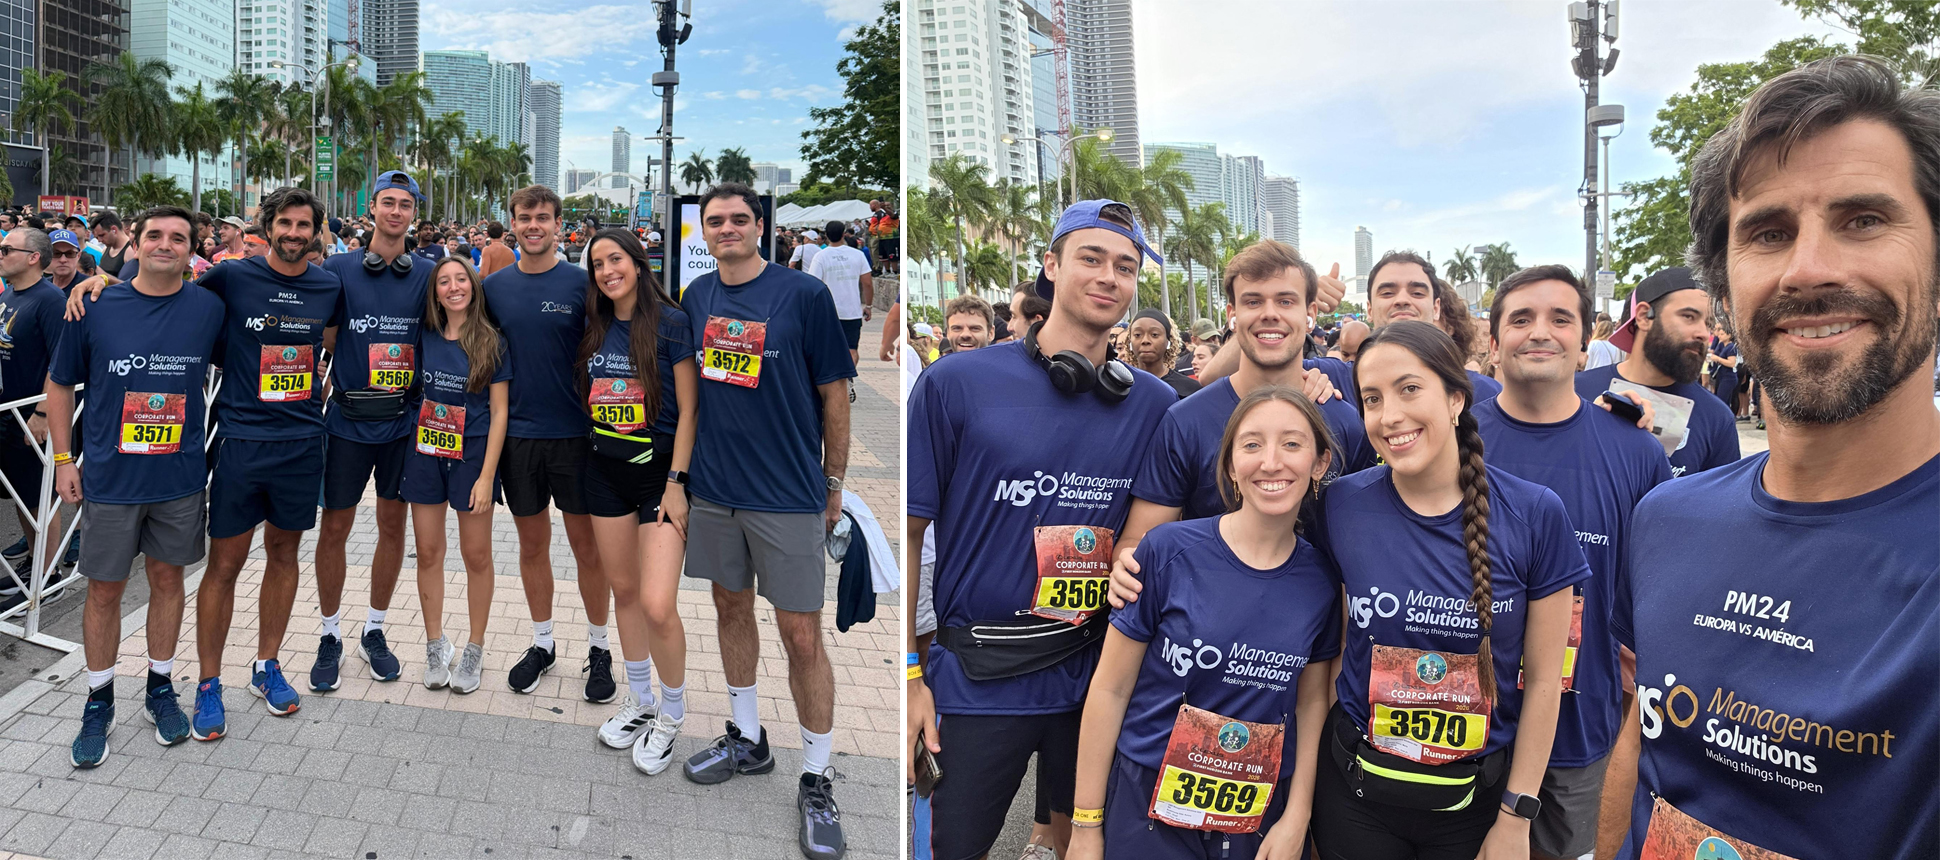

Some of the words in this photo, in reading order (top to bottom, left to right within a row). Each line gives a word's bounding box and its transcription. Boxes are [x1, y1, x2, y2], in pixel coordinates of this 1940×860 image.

[280, 314, 323, 325] Management
[280, 322, 310, 330] Solutions
[379, 322, 408, 330] Solutions
[148, 362, 186, 371] Solutions
[149, 354, 202, 364] Management
[712, 350, 752, 374] 3572
[270, 374, 304, 390] 3574
[376, 370, 410, 386] 3568
[434, 378, 463, 389] Solutions
[598, 405, 636, 422] 3570
[133, 425, 172, 442] 3571
[422, 428, 456, 449] 3569
[1058, 487, 1113, 500] Solutions
[1057, 501, 1078, 509] Making
[1078, 502, 1095, 510] things
[1056, 560, 1098, 569] CORPORATE
[1050, 580, 1110, 608] 3568
[1724, 590, 1792, 622] PM24
[1405, 608, 1480, 629] Solutions
[1404, 625, 1430, 634] Making
[1430, 628, 1452, 638] things
[1693, 614, 1737, 632] EUROPA
[1738, 622, 1752, 635] VS
[1752, 628, 1814, 652] AMÉRICA
[1225, 660, 1292, 682] Solutions
[1222, 676, 1246, 686] Making
[1247, 680, 1266, 690] things
[1266, 683, 1287, 692] happen
[1391, 690, 1448, 702] CORPORATE
[1452, 694, 1470, 704] RUN
[1390, 710, 1468, 748] 3570
[1706, 687, 1896, 758] Management
[1423, 748, 1458, 760] Runner
[1702, 718, 1818, 774] Solutions
[1188, 752, 1244, 772] CORPORATE
[1246, 764, 1264, 774] RUN
[1705, 748, 1738, 772] Making
[1740, 762, 1774, 782] things
[1776, 770, 1823, 794] happen
[1172, 772, 1258, 814] 3569
[1205, 816, 1238, 827] Runner
